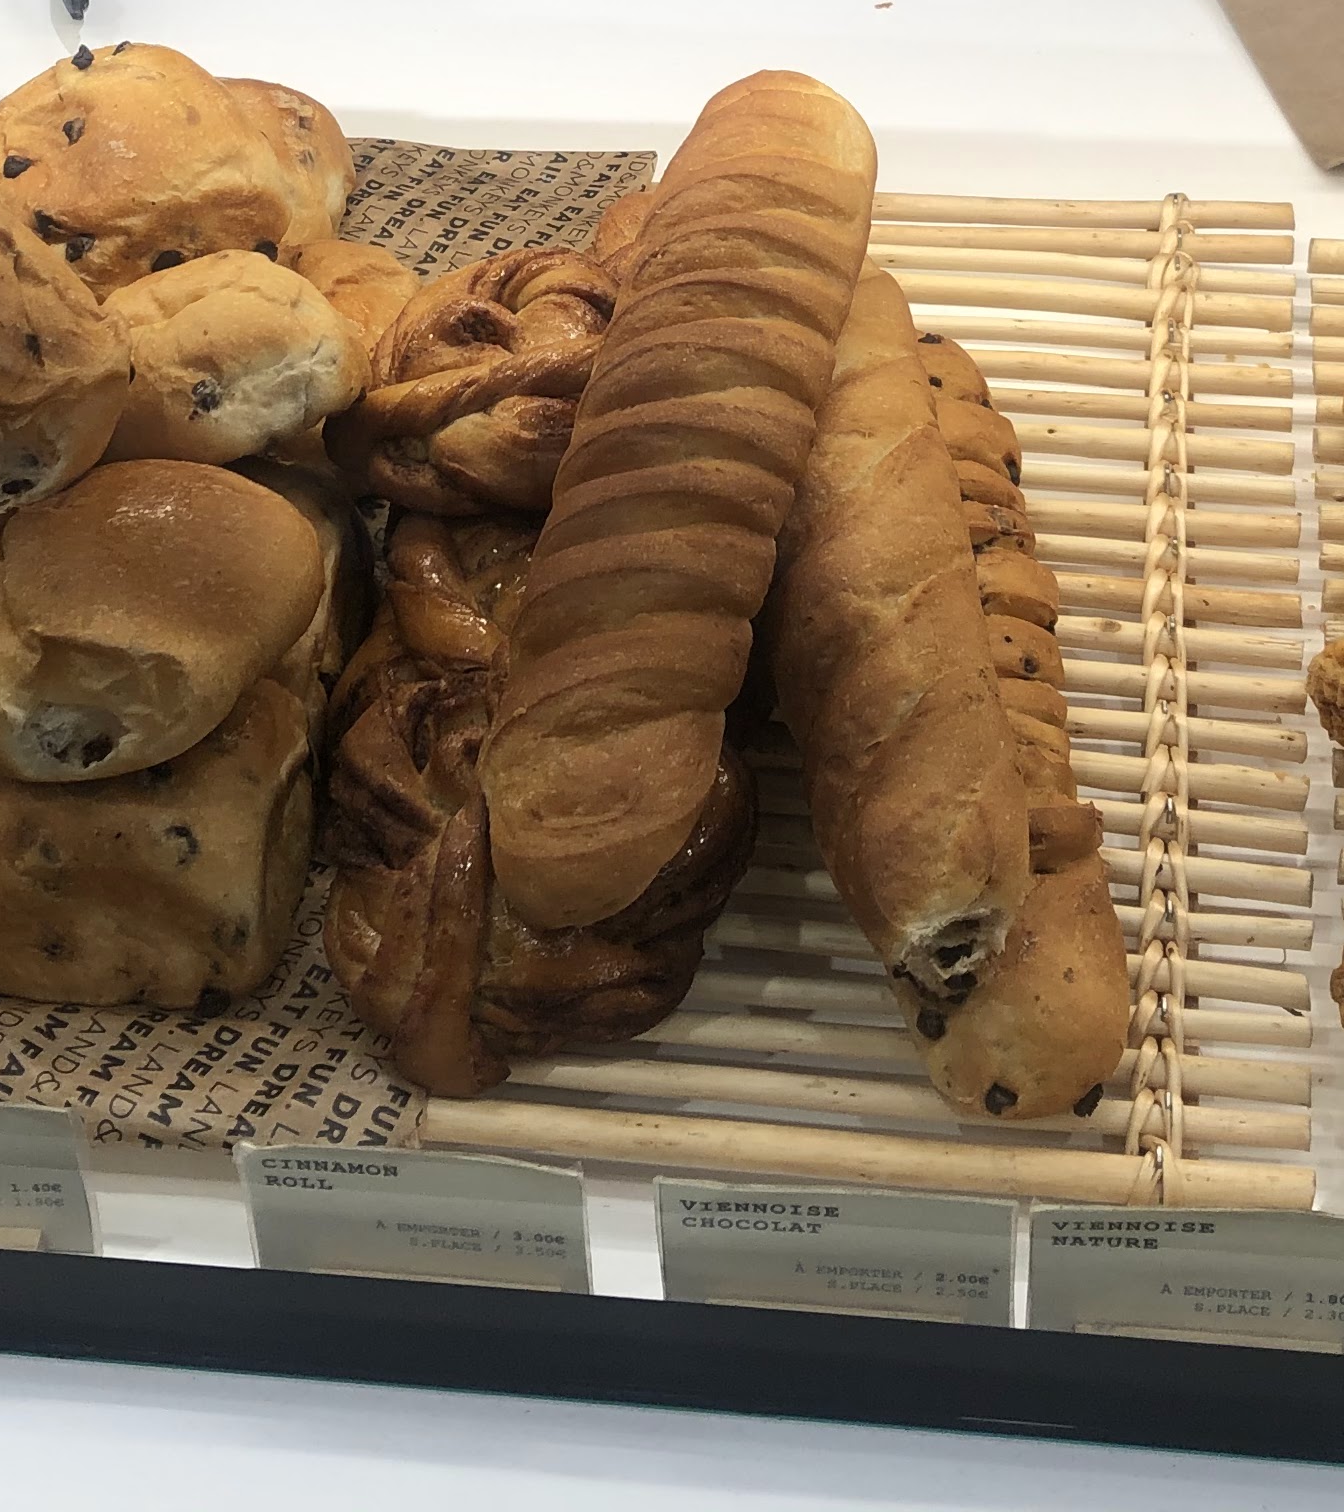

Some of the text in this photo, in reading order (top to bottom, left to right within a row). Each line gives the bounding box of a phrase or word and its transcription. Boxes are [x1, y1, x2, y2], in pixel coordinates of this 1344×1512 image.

[261, 1158, 398, 1178] CINNAMON
[265, 1176, 333, 1190] ROLL
[680, 1199, 839, 1218] VIENNOISE
[681, 1216, 822, 1234] CHOCOLAT
[1052, 1221, 1215, 1234] VIENNOISE
[1052, 1236, 1159, 1250] NATURE
[1184, 1285, 1272, 1301] EMPORTER
